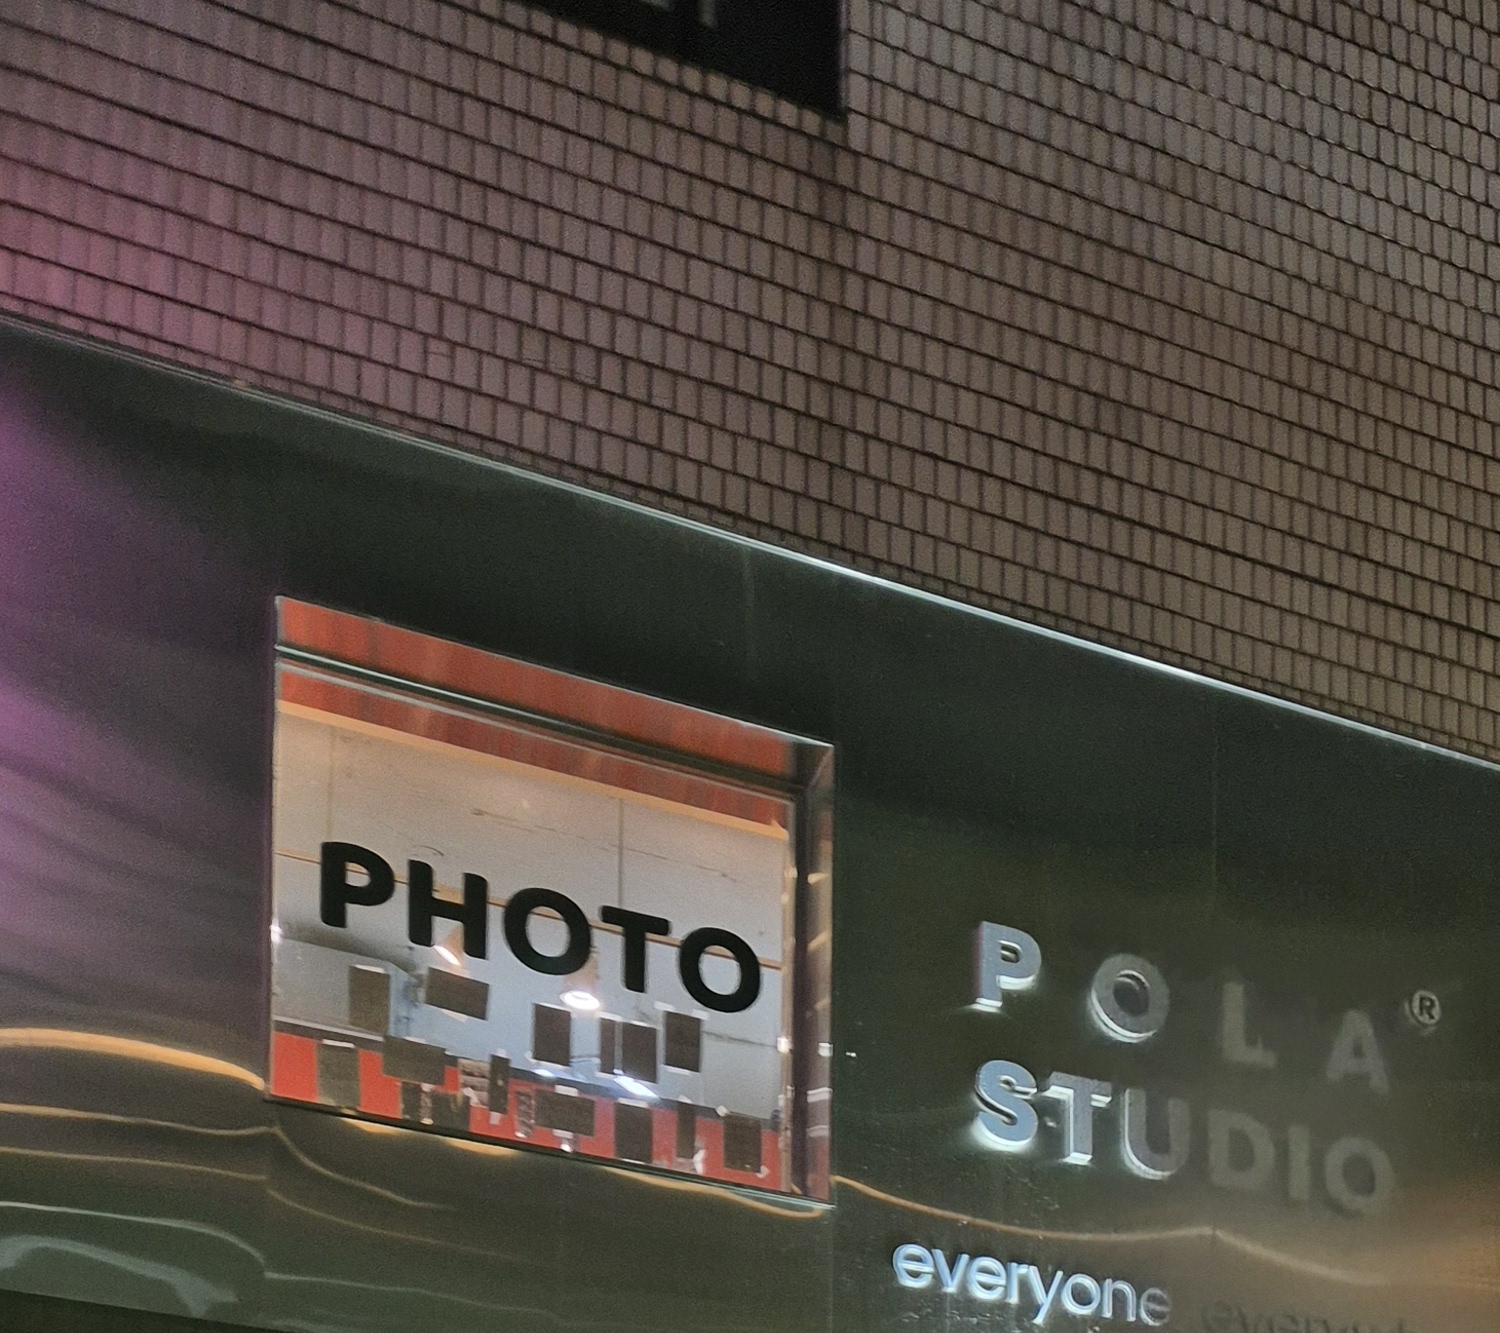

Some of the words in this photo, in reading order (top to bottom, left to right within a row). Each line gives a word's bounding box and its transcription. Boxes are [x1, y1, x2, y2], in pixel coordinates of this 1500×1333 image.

[319, 841, 762, 1014] PHOTO
[970, 1059, 1396, 1220] STUDIO
[892, 1241, 1172, 1326] everyone
